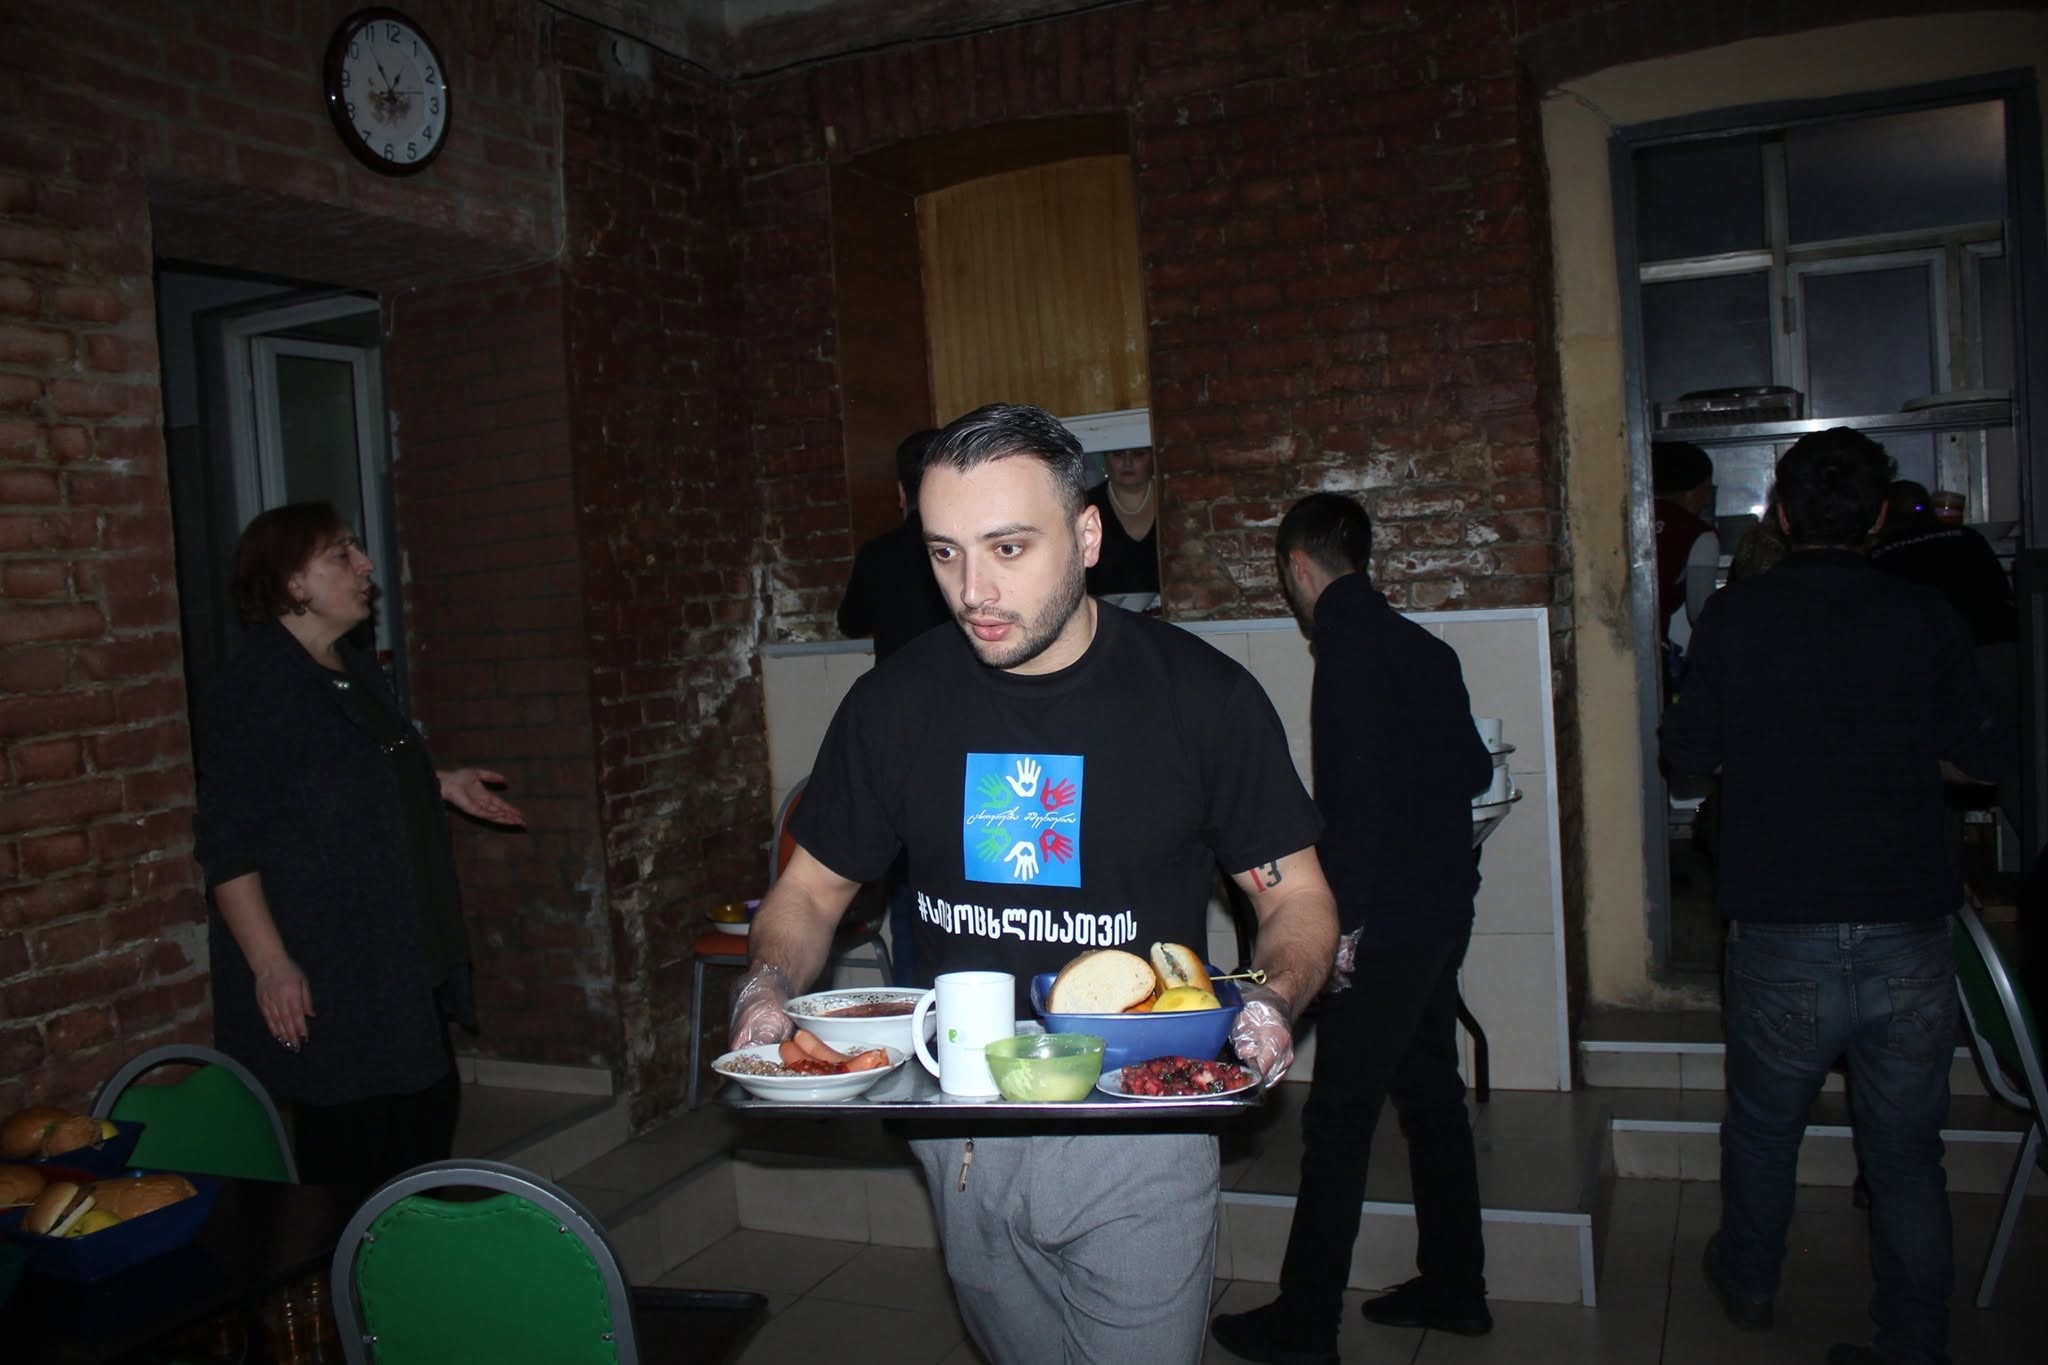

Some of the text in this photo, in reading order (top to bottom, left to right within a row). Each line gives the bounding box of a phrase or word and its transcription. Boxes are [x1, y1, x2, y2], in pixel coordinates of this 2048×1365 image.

[365, 24, 375, 43] 11
[386, 23, 400, 43] 12
[412, 40, 417, 57] 1
[342, 70, 350, 88] 9
[425, 66, 435, 84] 2
[430, 97, 439, 114] 3
[361, 130, 371, 145] 7
[422, 125, 432, 141] 4
[384, 143, 394, 161] 6
[406, 142, 416, 160] 5
[917, 890, 1138, 947] #სიცოცხლისათვის
